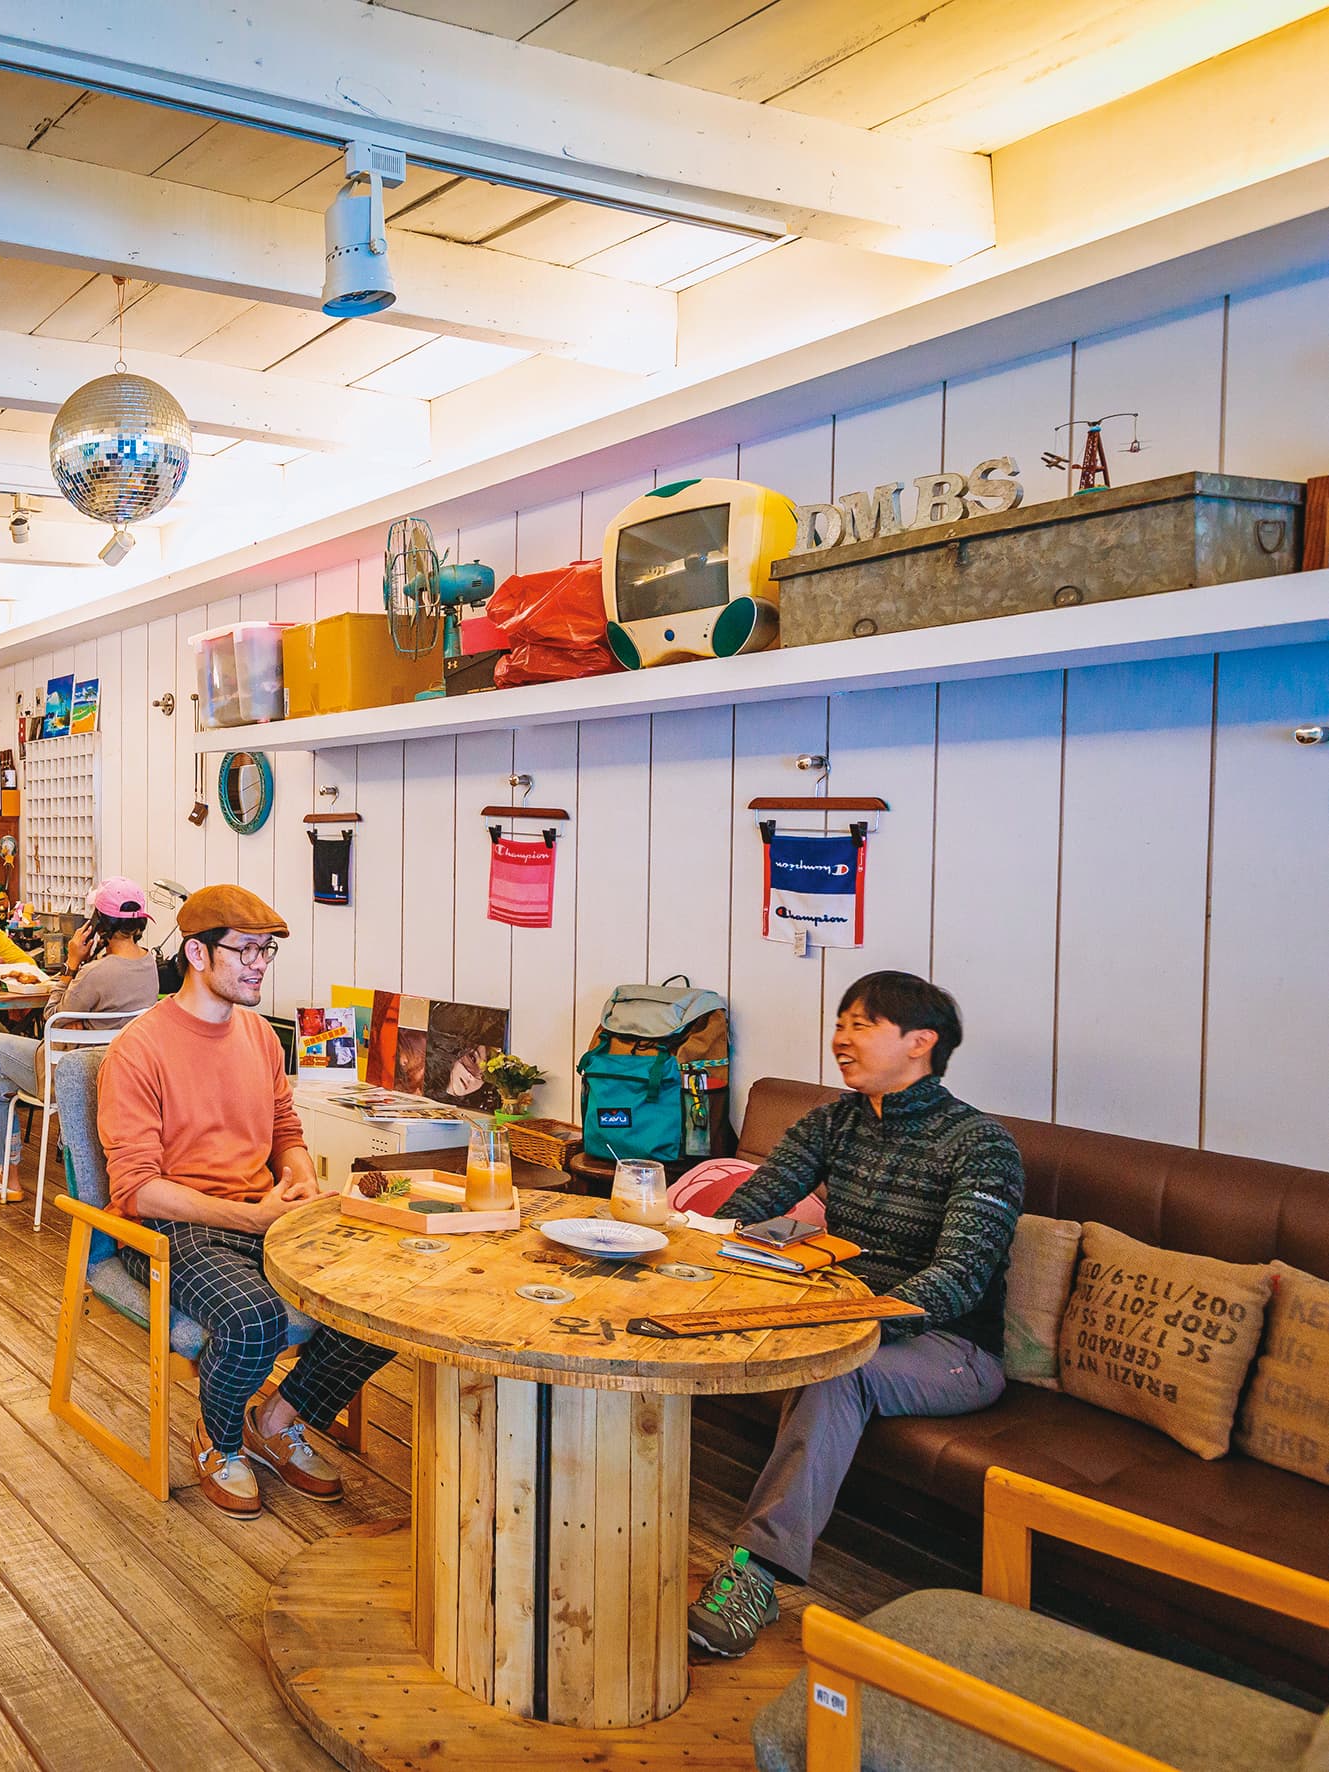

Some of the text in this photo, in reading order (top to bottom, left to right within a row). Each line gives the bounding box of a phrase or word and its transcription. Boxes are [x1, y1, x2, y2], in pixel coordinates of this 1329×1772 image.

[789, 456, 1024, 556] DMBS
[495, 843, 550, 864] Champion
[775, 859, 849, 876] Champion
[775, 906, 848, 927] Champion
[600, 1115, 627, 1123] KAVU
[1164, 1309, 1238, 1345] CROP
[1077, 1330, 1162, 1371] CERRADO
[1177, 1337, 1212, 1363] SC
[1105, 1361, 1178, 1404] BRAZIL
